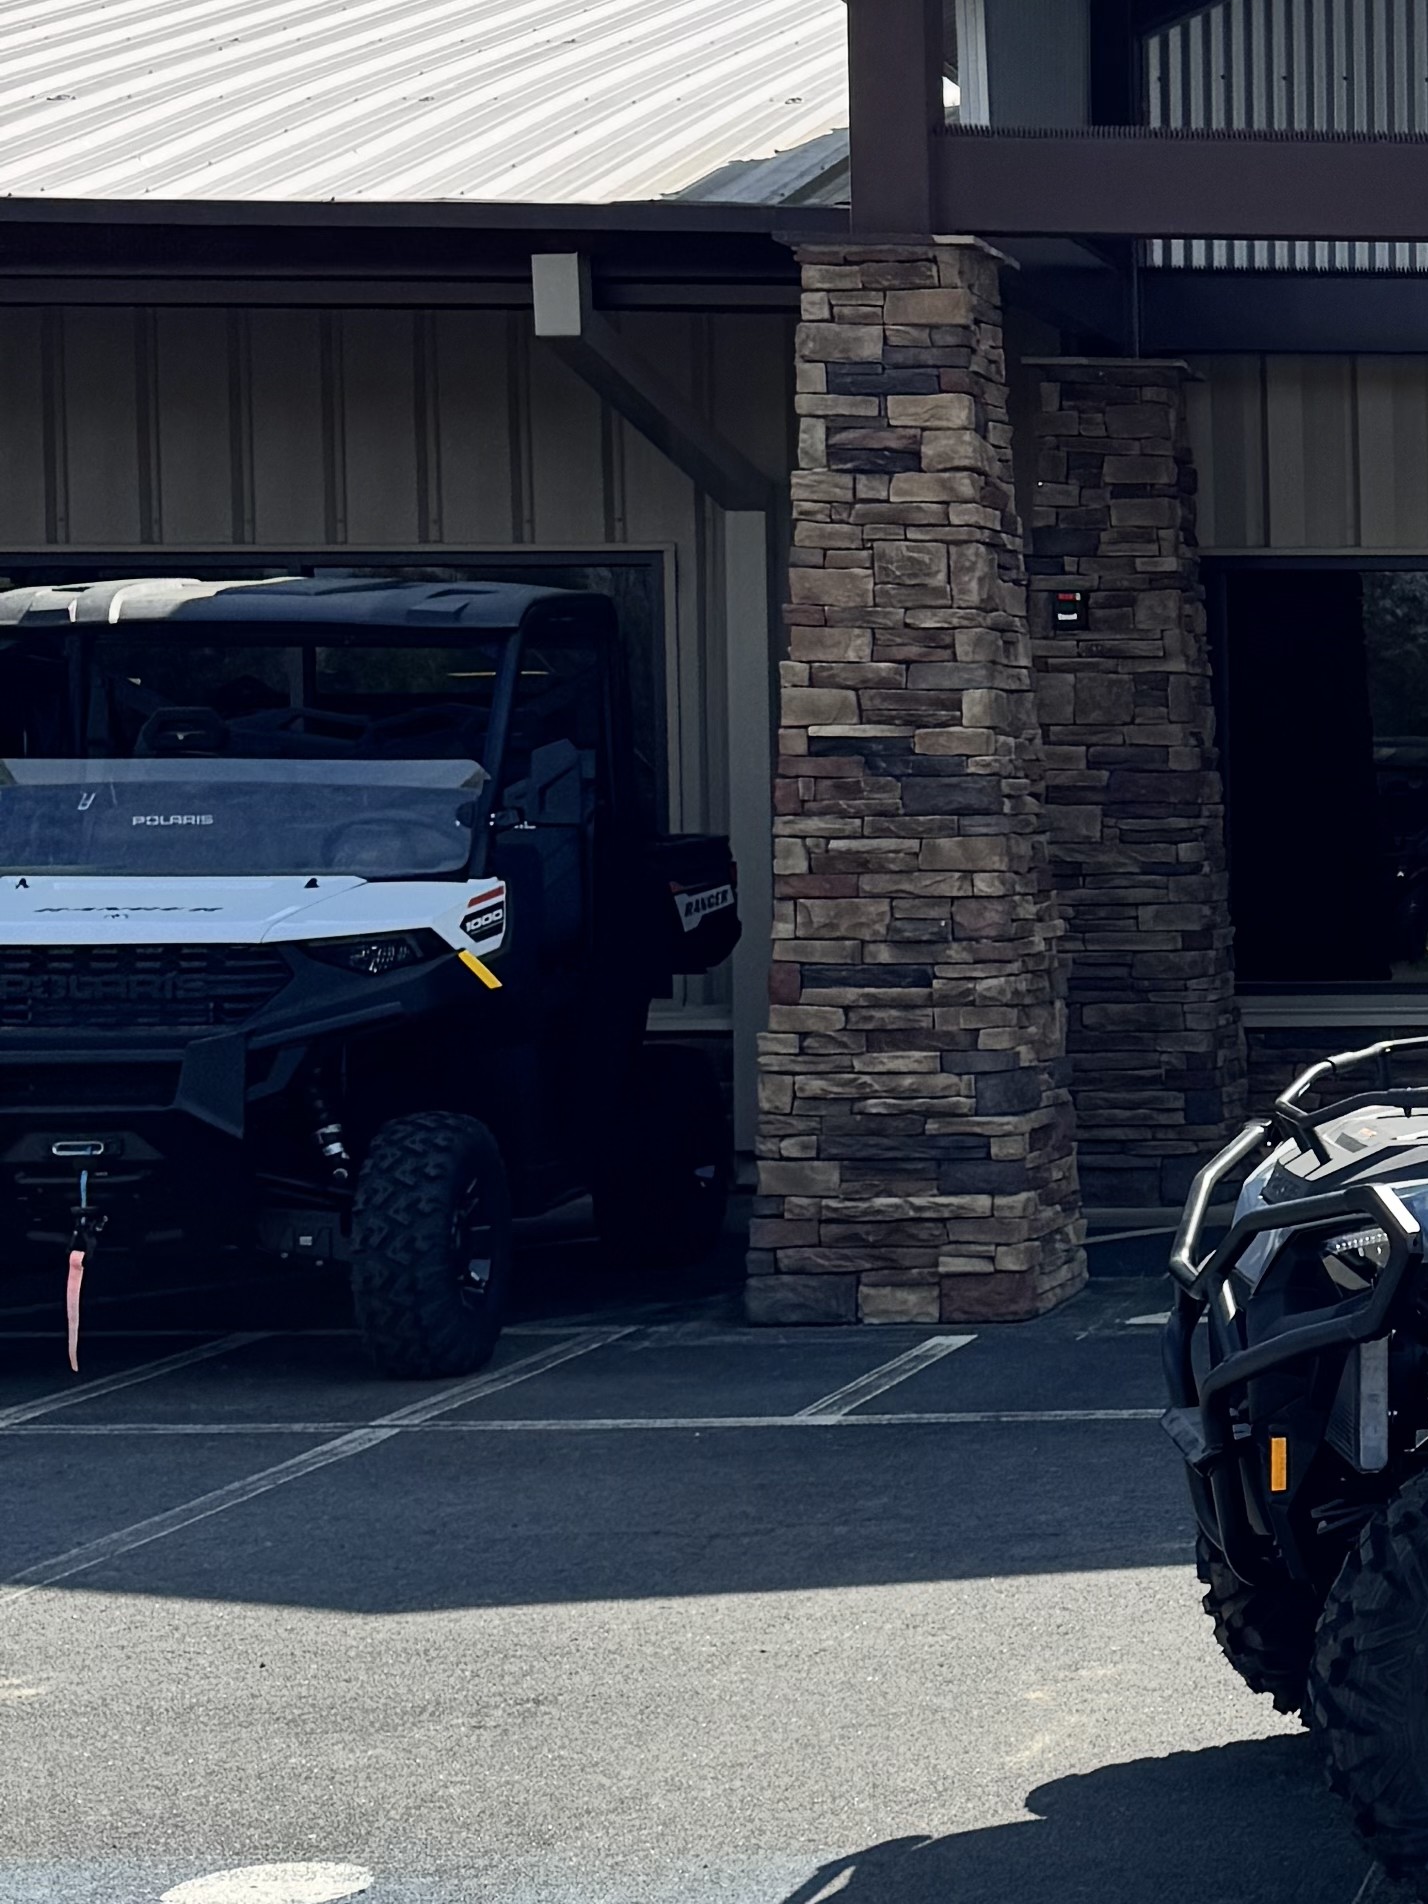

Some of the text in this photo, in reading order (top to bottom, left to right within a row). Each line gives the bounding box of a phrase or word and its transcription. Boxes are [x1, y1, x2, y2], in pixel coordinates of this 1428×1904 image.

[132, 814, 214, 826] POLARIS
[684, 889, 729, 917] RANGER
[465, 908, 503, 933] 1000
